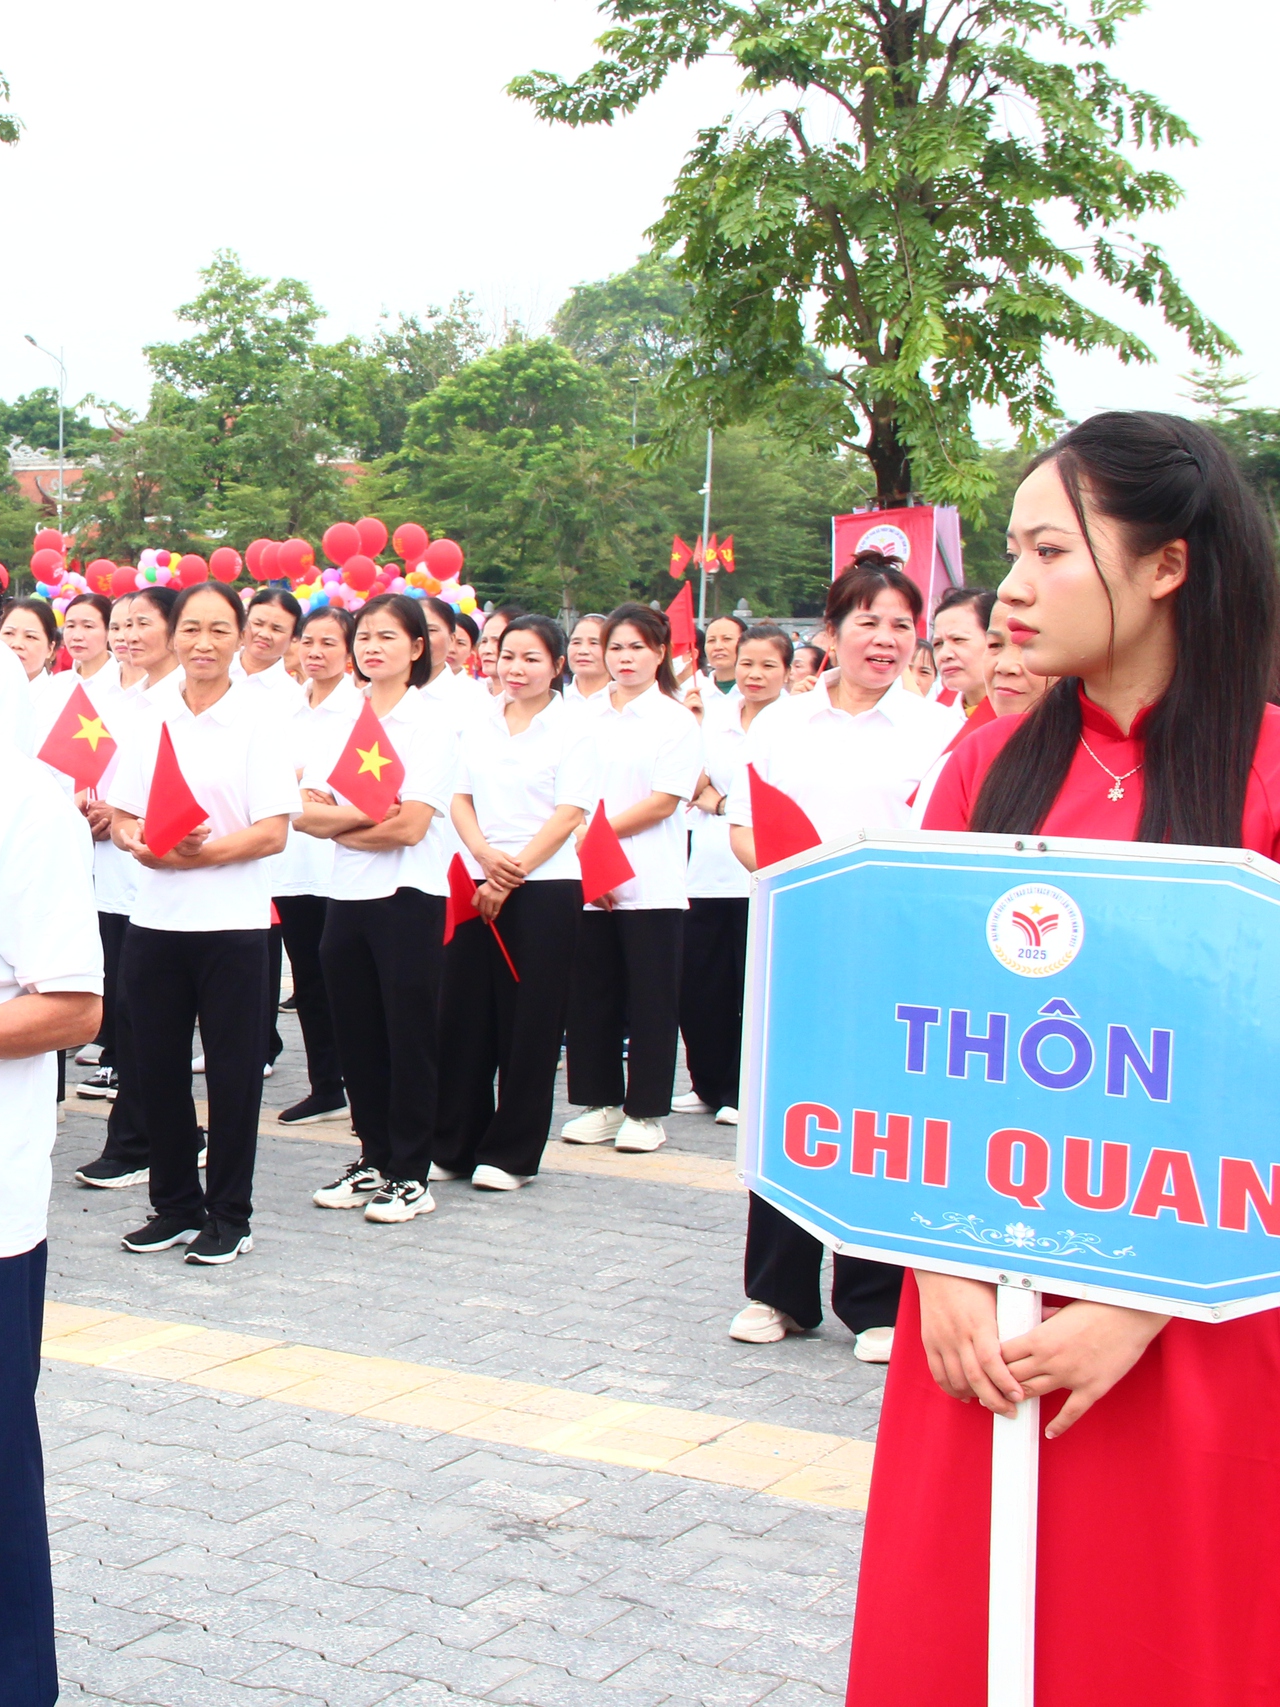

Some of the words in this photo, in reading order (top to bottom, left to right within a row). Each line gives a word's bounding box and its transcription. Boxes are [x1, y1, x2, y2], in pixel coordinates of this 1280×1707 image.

[1018, 948, 1047, 960] 2025
[894, 996, 1174, 1103] THÔN
[782, 1100, 951, 1189] CHI
[984, 1127, 1280, 1239] QUAN
